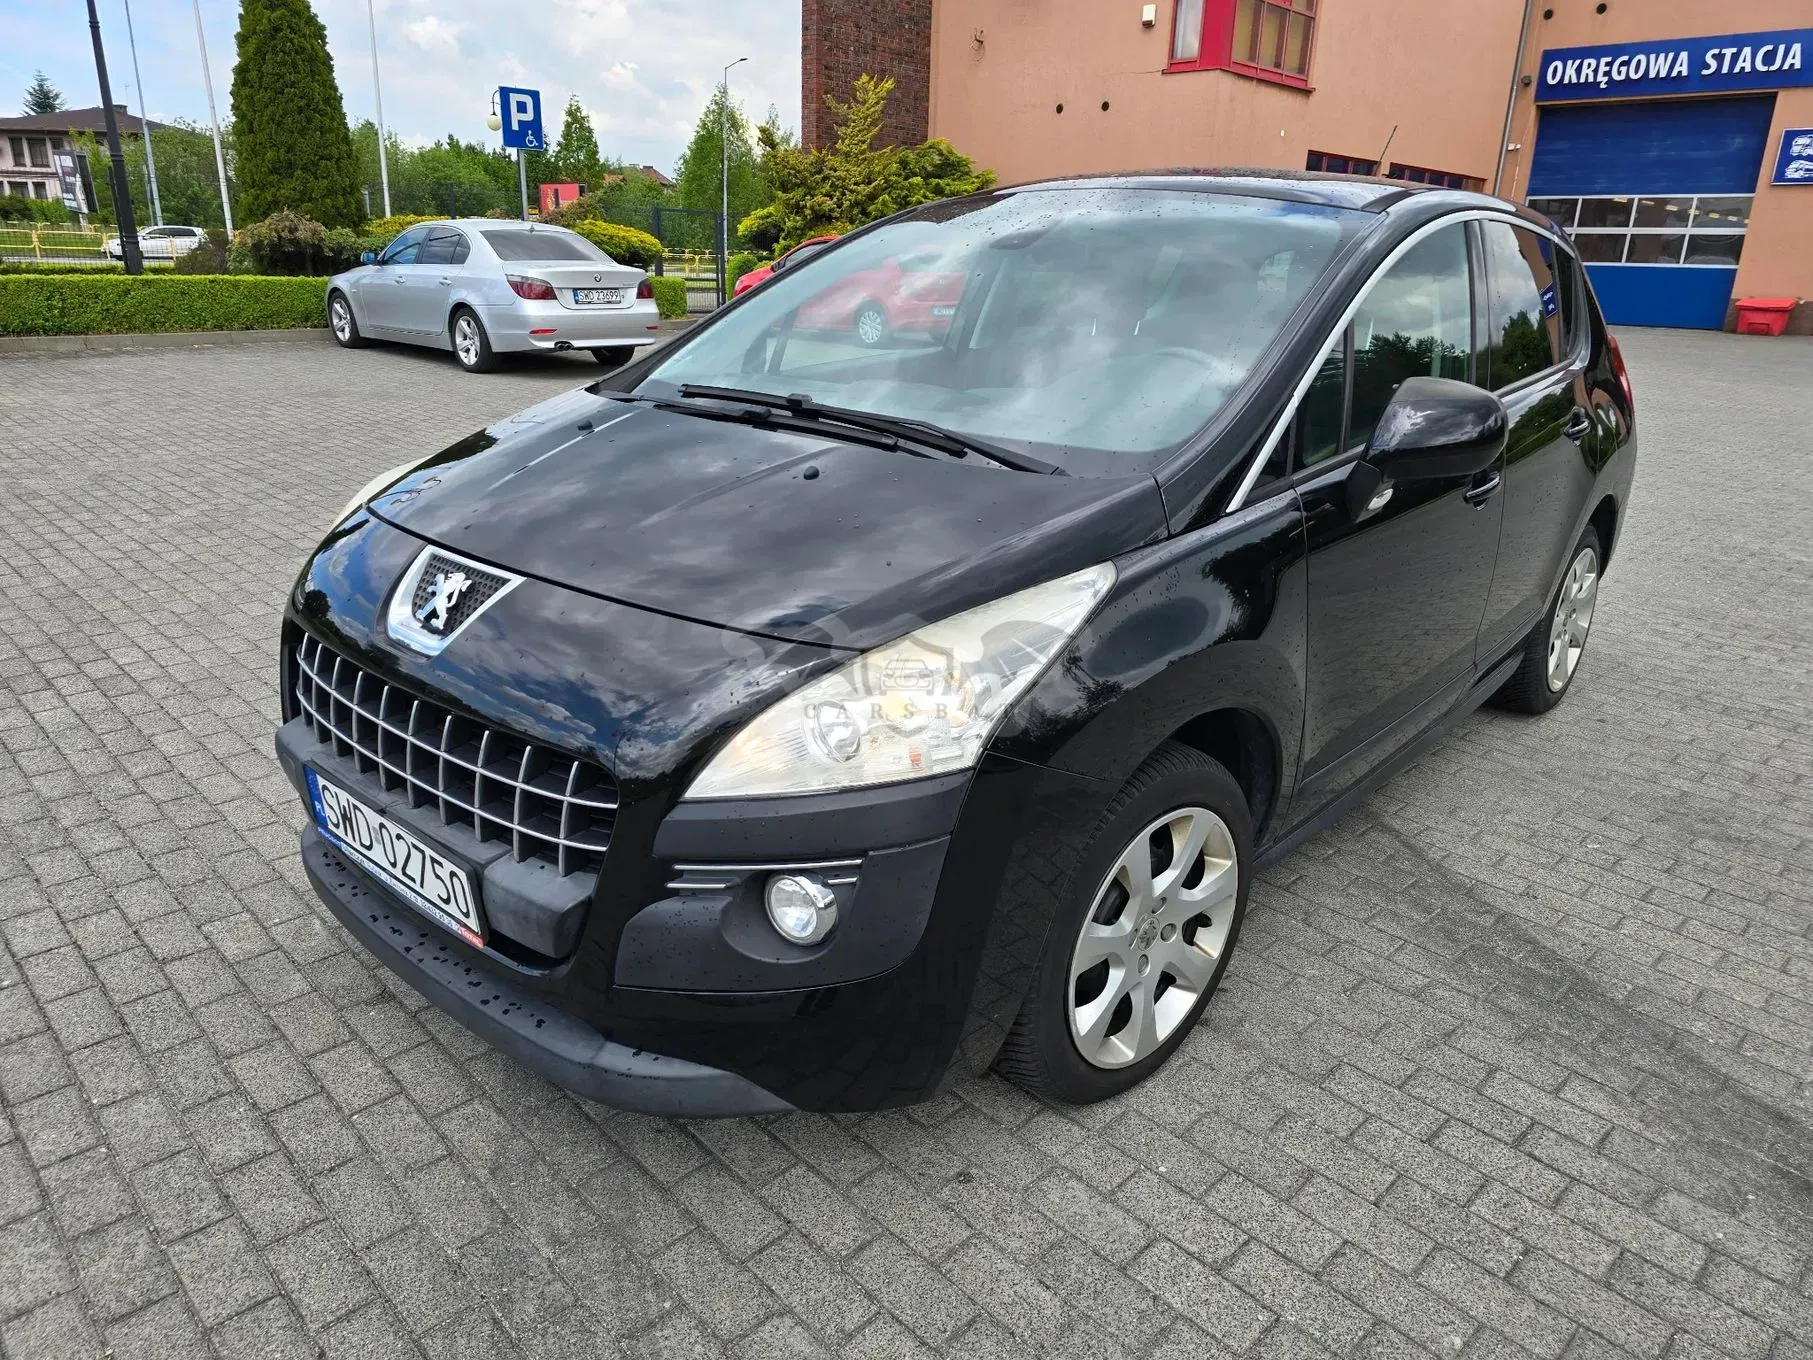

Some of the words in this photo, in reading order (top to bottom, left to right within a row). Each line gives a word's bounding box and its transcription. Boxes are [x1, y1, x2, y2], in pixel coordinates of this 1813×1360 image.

[1546, 51, 1689, 88] OKRĘGOWA
[1701, 43, 1802, 76] STACJA
[509, 92, 534, 131] P
[578, 290, 595, 300] SWD
[321, 784, 374, 852] SWD
[378, 822, 471, 919] 02750
